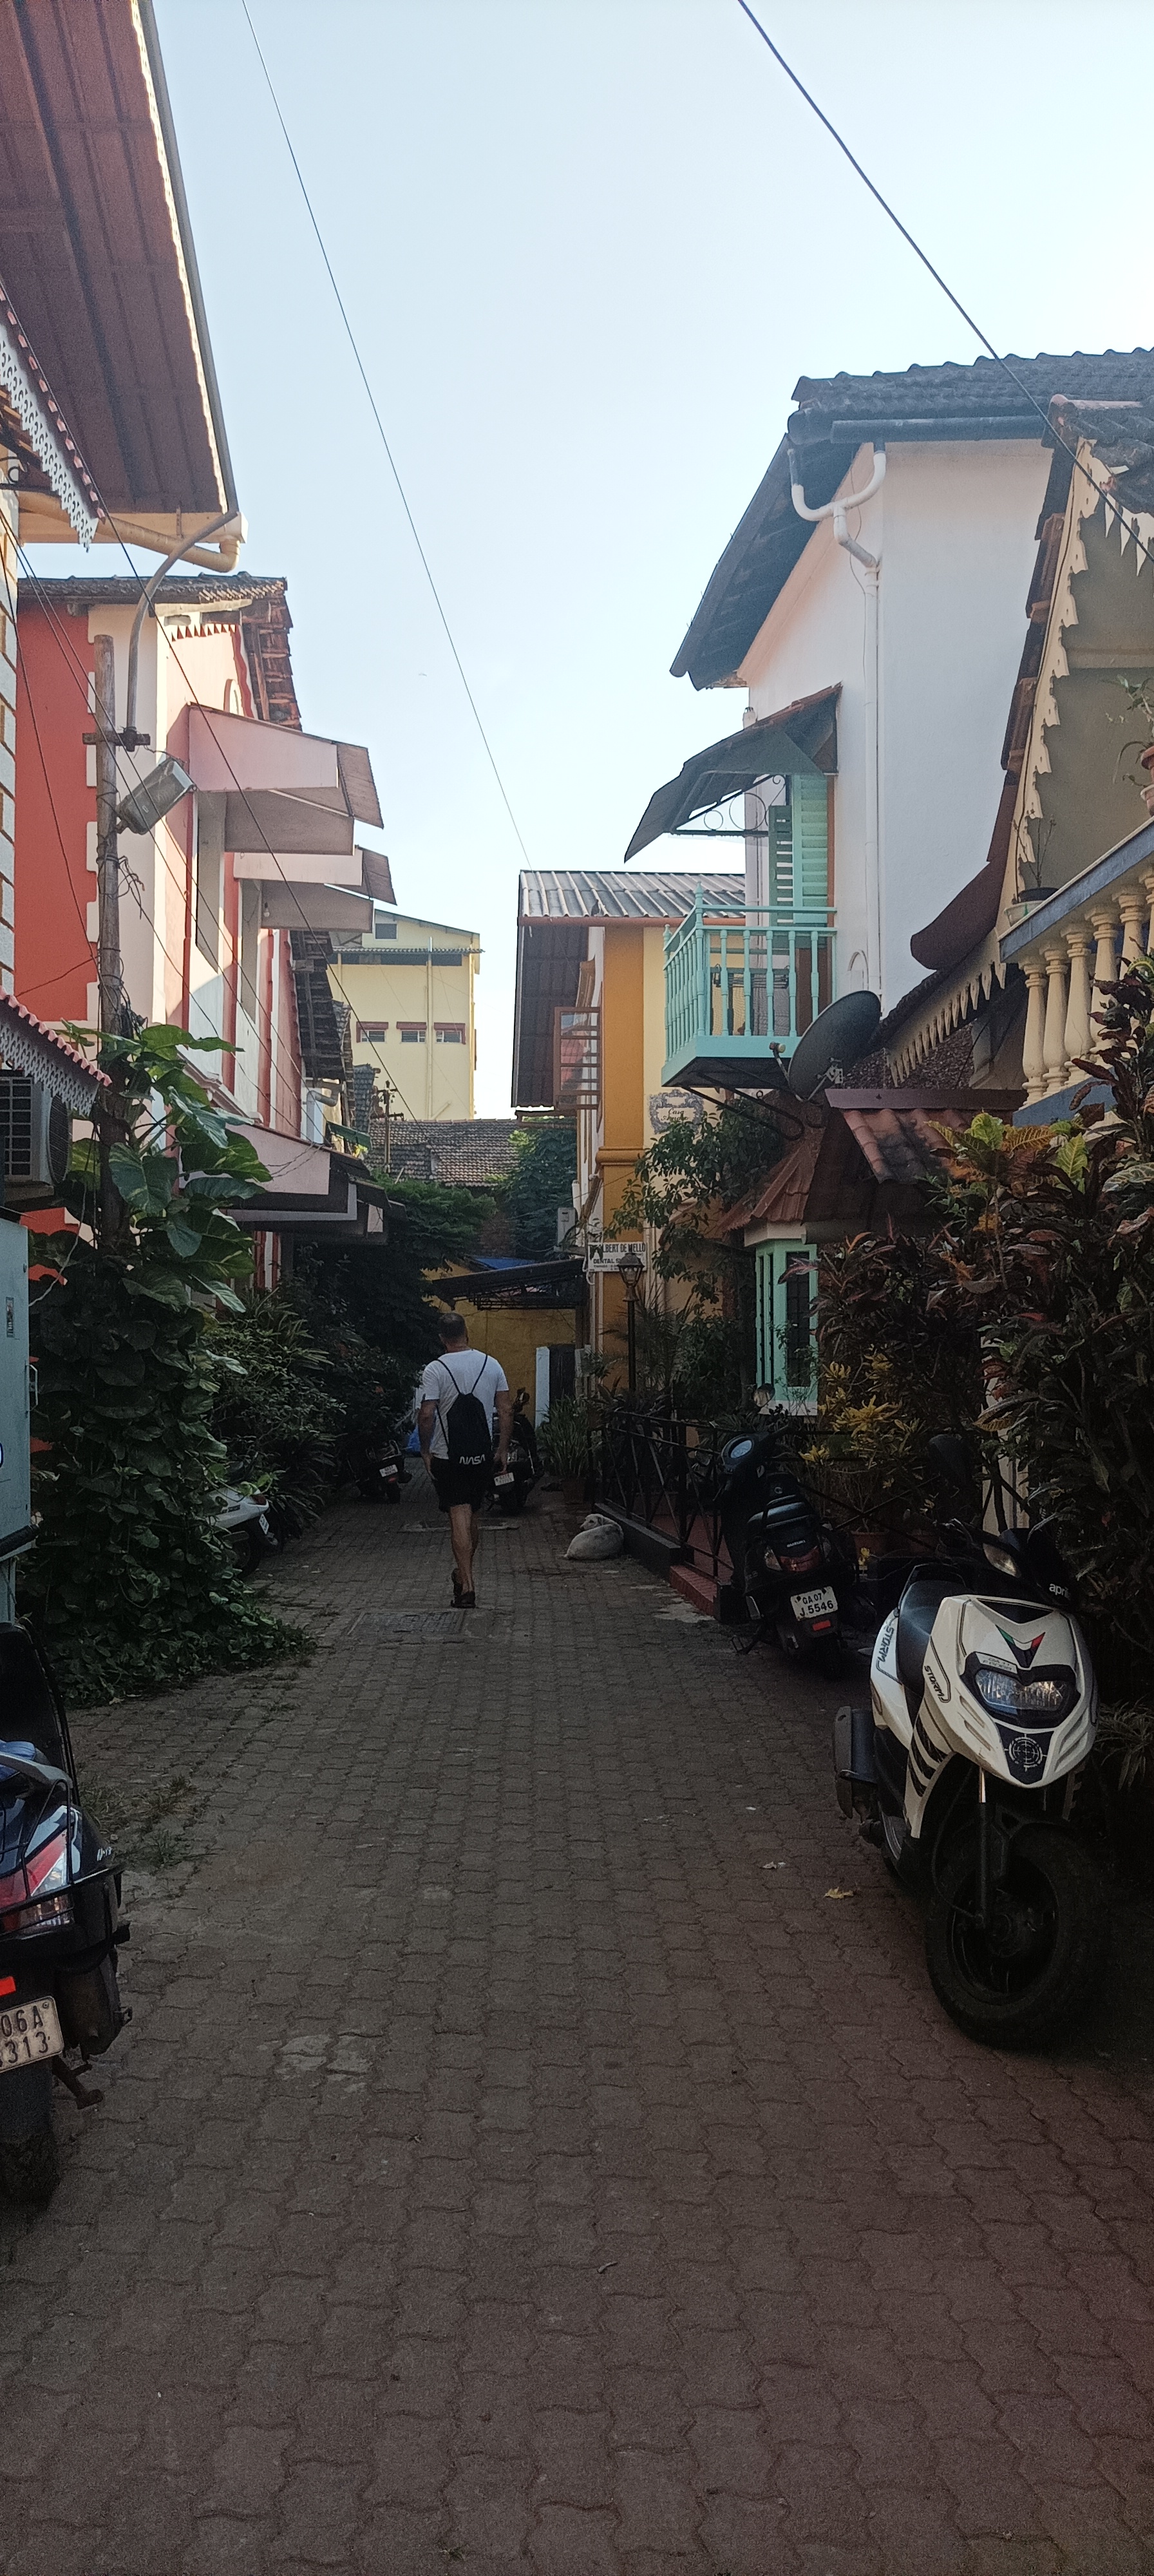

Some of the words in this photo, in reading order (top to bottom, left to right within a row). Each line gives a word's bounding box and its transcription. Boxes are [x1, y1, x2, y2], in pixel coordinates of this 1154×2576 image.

[599, 1244, 619, 1253] LBERT
[620, 1244, 627, 1253] DE
[628, 1243, 646, 1252] MELLO
[459, 1454, 486, 1465] NASA
[802, 1596, 813, 1604] GA
[808, 1600, 834, 1614] 5546
[878, 1626, 894, 1662] STORM
[924, 1665, 945, 1698] STORM
[0, 2031, 49, 2068] 313
